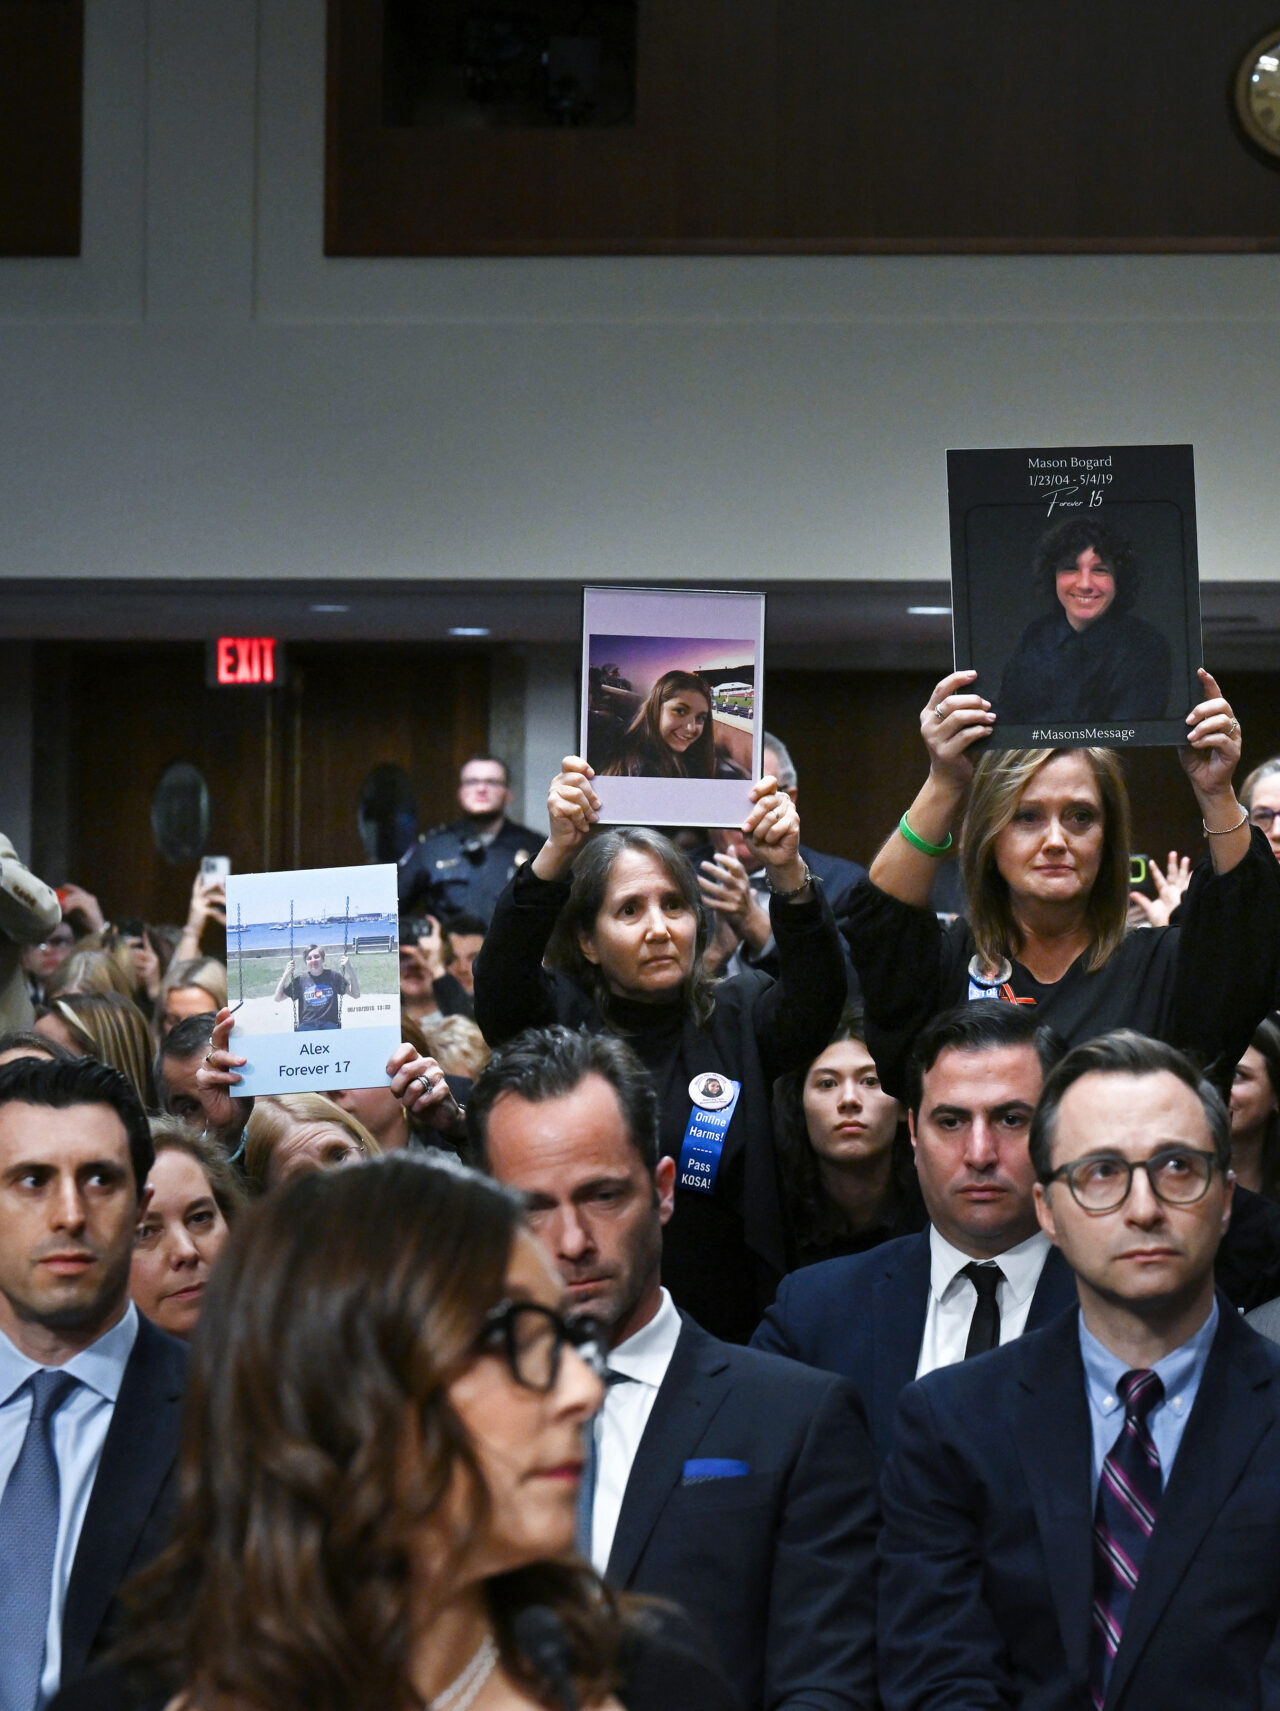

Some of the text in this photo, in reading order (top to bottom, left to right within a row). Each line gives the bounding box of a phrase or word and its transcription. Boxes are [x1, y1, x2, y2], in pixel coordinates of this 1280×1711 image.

[1028, 455, 1112, 471] Mason Bogard
[1029, 474, 1070, 487] 1/23/04
[1080, 473, 1113, 486] 5/4/19
[1042, 486, 1104, 518] Forever 15
[217, 637, 276, 684] EXIT
[1032, 728, 1135, 741] #MasonsMessage
[299, 1043, 330, 1055] Alex
[279, 1061, 351, 1077] Forever 17
[695, 1112, 727, 1127] Online
[689, 1126, 724, 1142] Harms!
[687, 1158, 711, 1173] Pass
[681, 1173, 711, 1189] KOSA!
